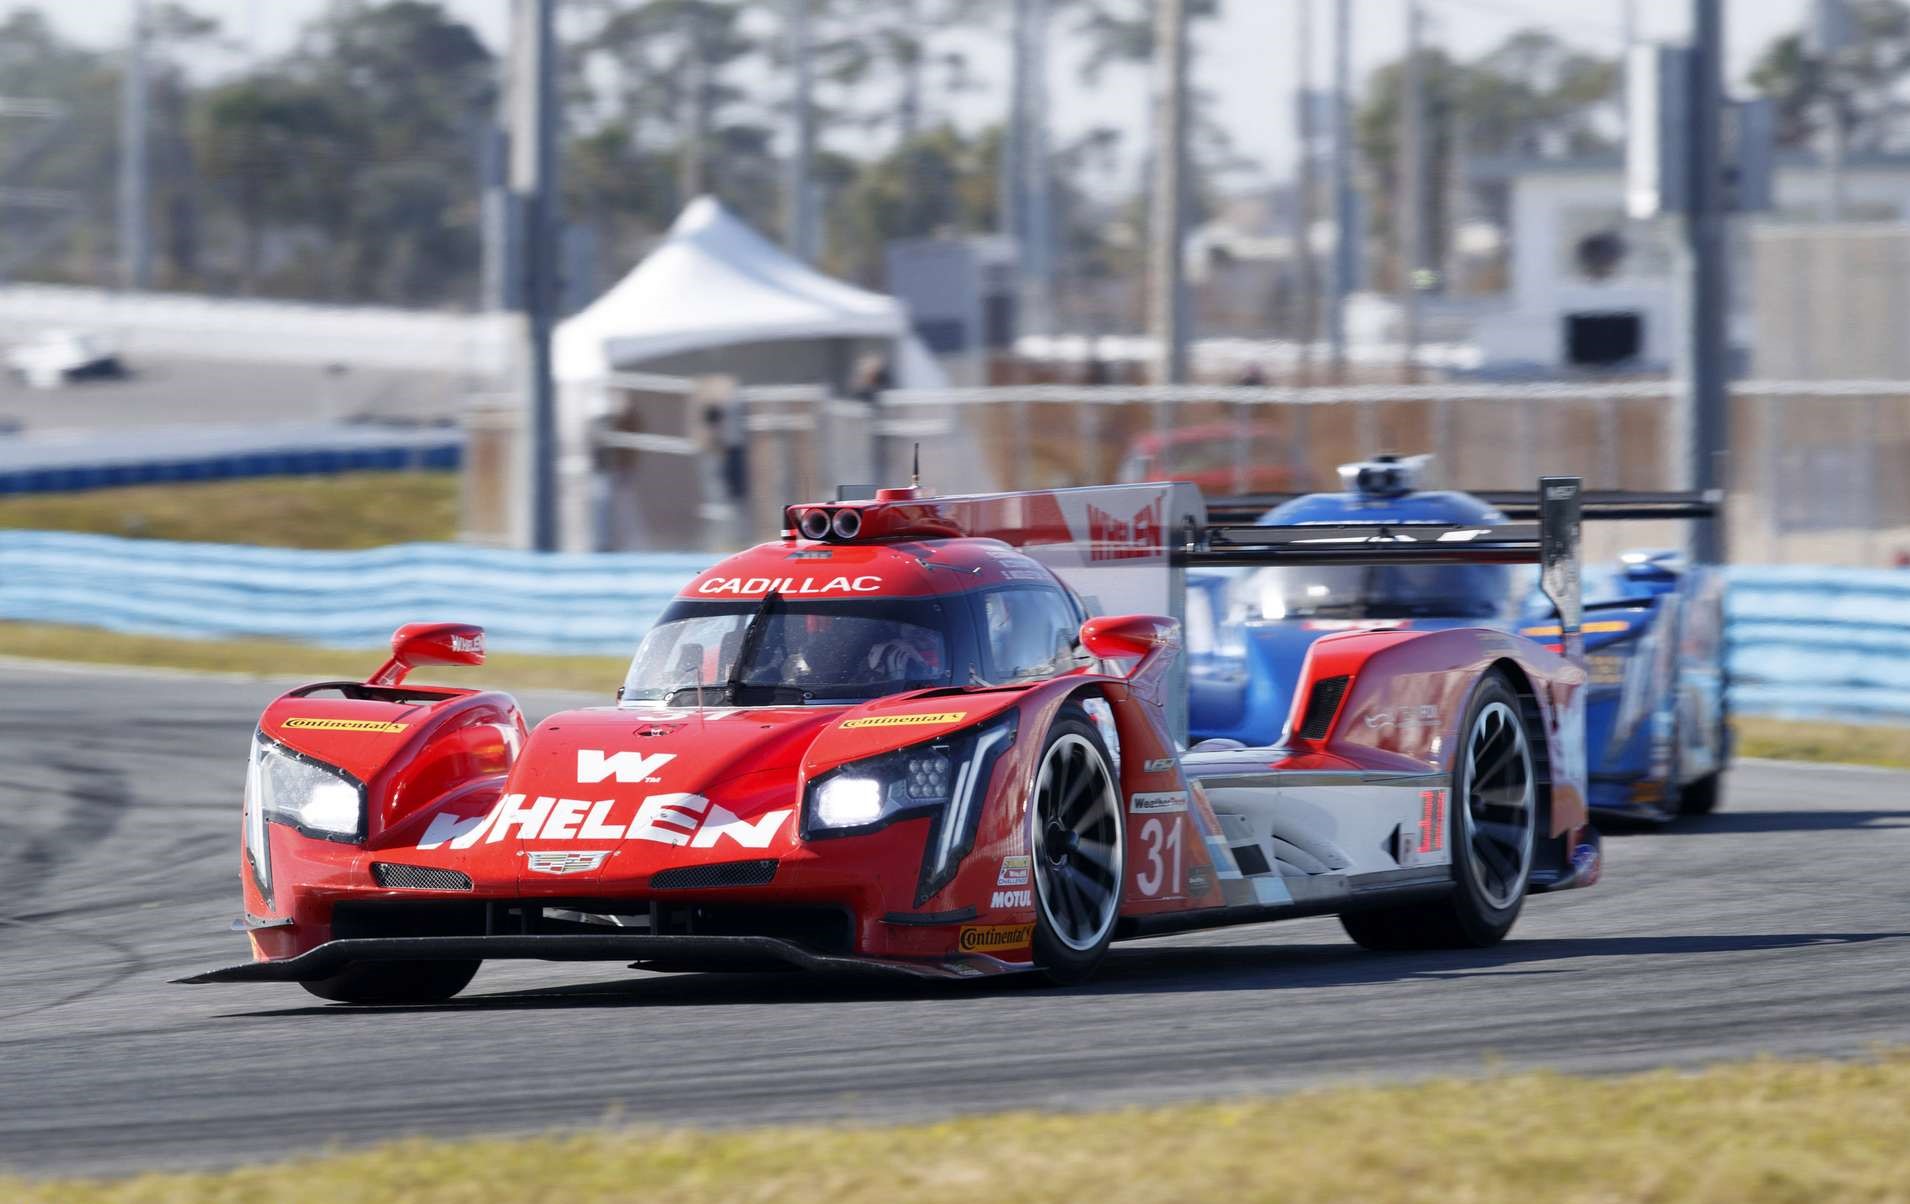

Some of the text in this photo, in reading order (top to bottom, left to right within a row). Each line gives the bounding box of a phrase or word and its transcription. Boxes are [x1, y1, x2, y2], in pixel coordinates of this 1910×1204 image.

[698, 575, 883, 594] CADILLAC
[286, 719, 386, 730] Continental
[843, 714, 944, 728] Continental
[577, 749, 677, 783] W
[416, 792, 794, 850] WHELEN
[1136, 816, 1183, 896] 31
[991, 891, 1031, 908] MOTUL
[961, 926, 1027, 950] Continental
